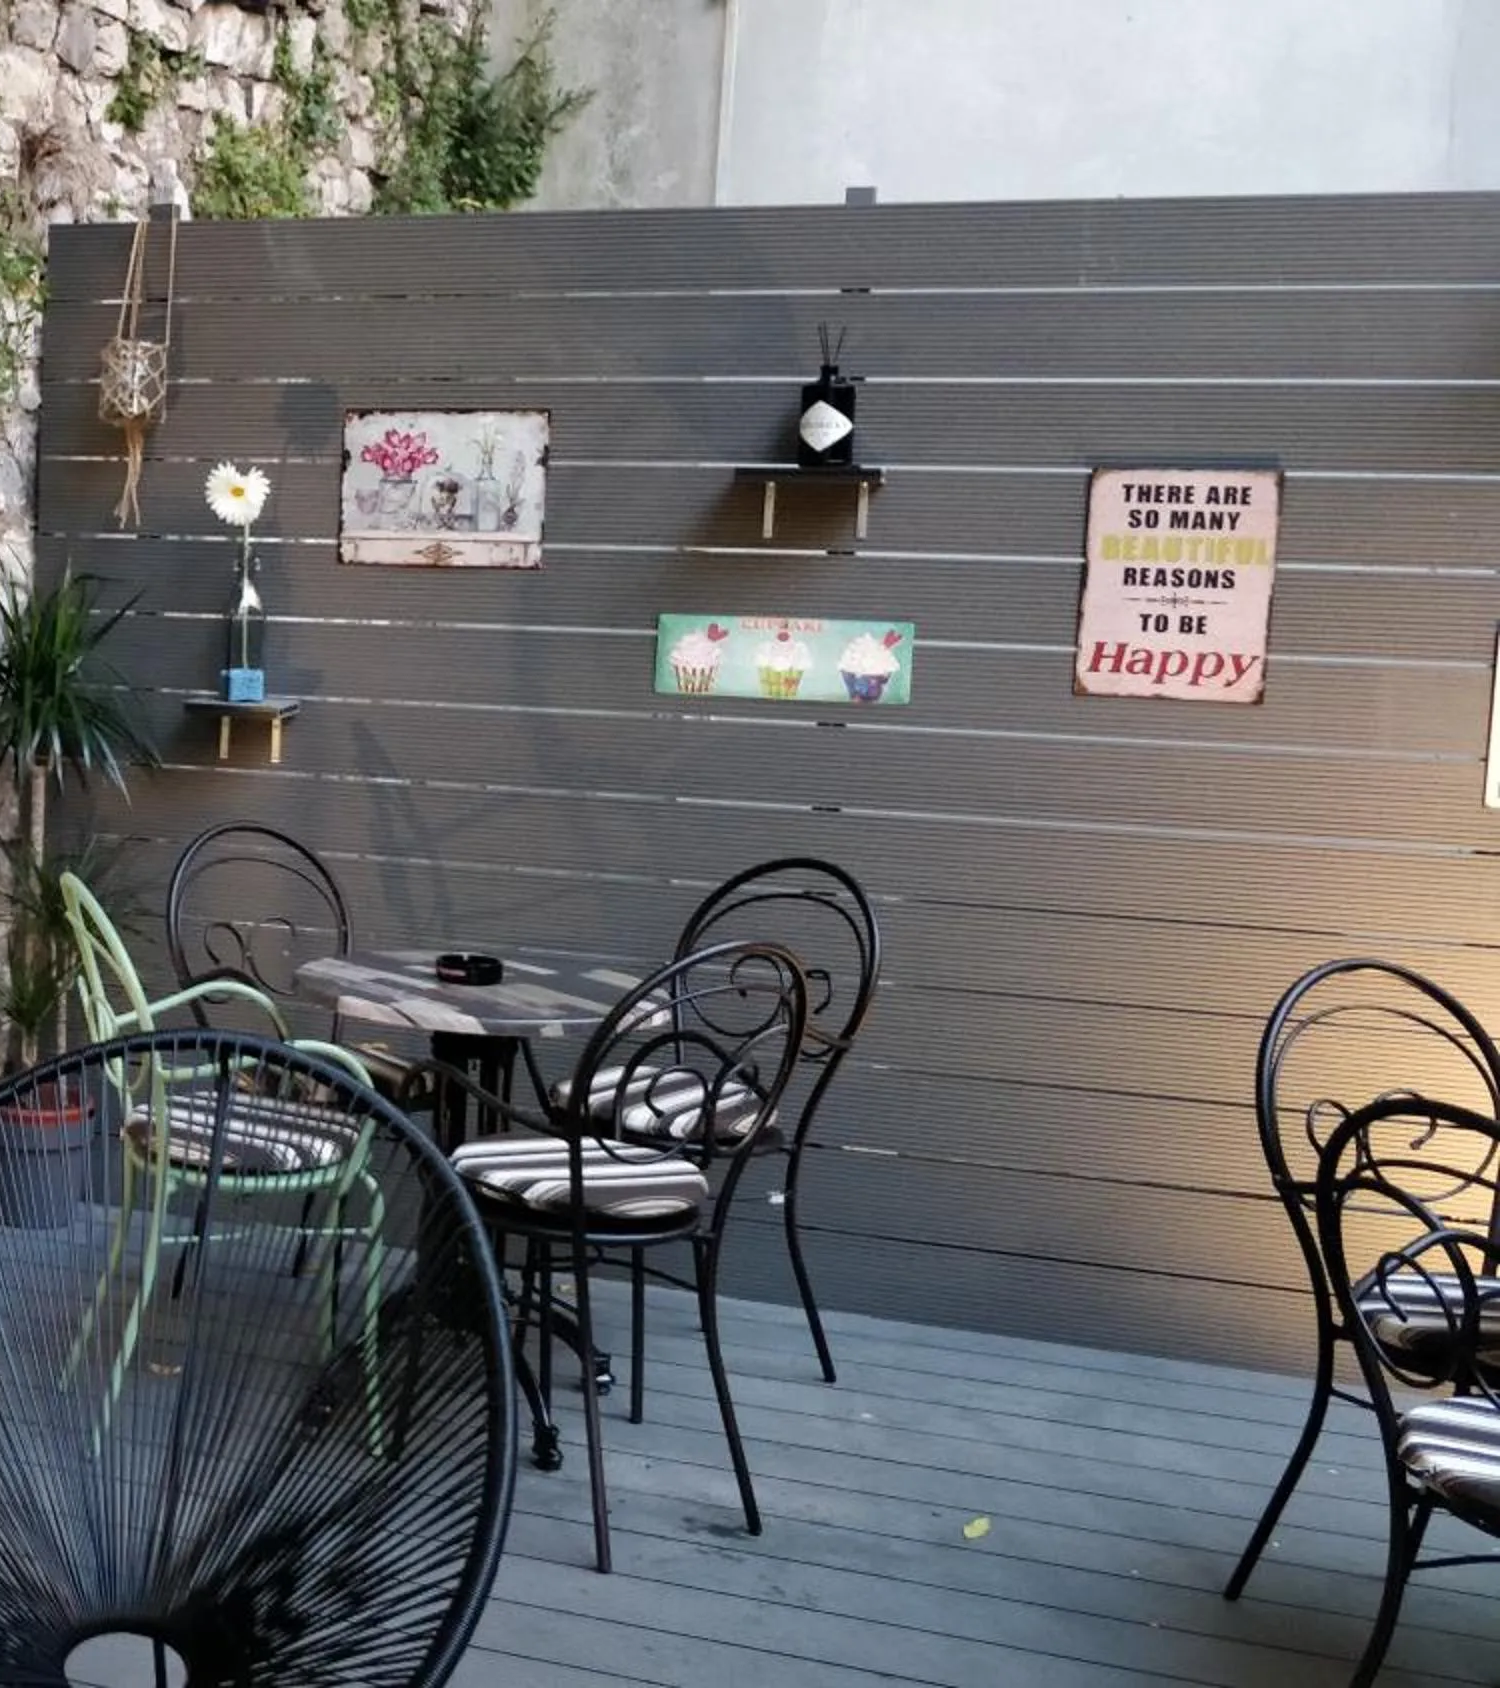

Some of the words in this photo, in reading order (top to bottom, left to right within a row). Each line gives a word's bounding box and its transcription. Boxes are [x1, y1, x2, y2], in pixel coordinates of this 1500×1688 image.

[1122, 484, 1195, 505] THERE
[1205, 485, 1252, 505] ARE
[1128, 509, 1160, 529] SO
[1169, 510, 1241, 531] MANY
[1102, 536, 1269, 565] BEAUTIFUL
[1123, 567, 1236, 589] REASONS
[1140, 614, 1169, 633] TO
[1178, 615, 1208, 635] BE
[1088, 641, 1260, 688] Happy
